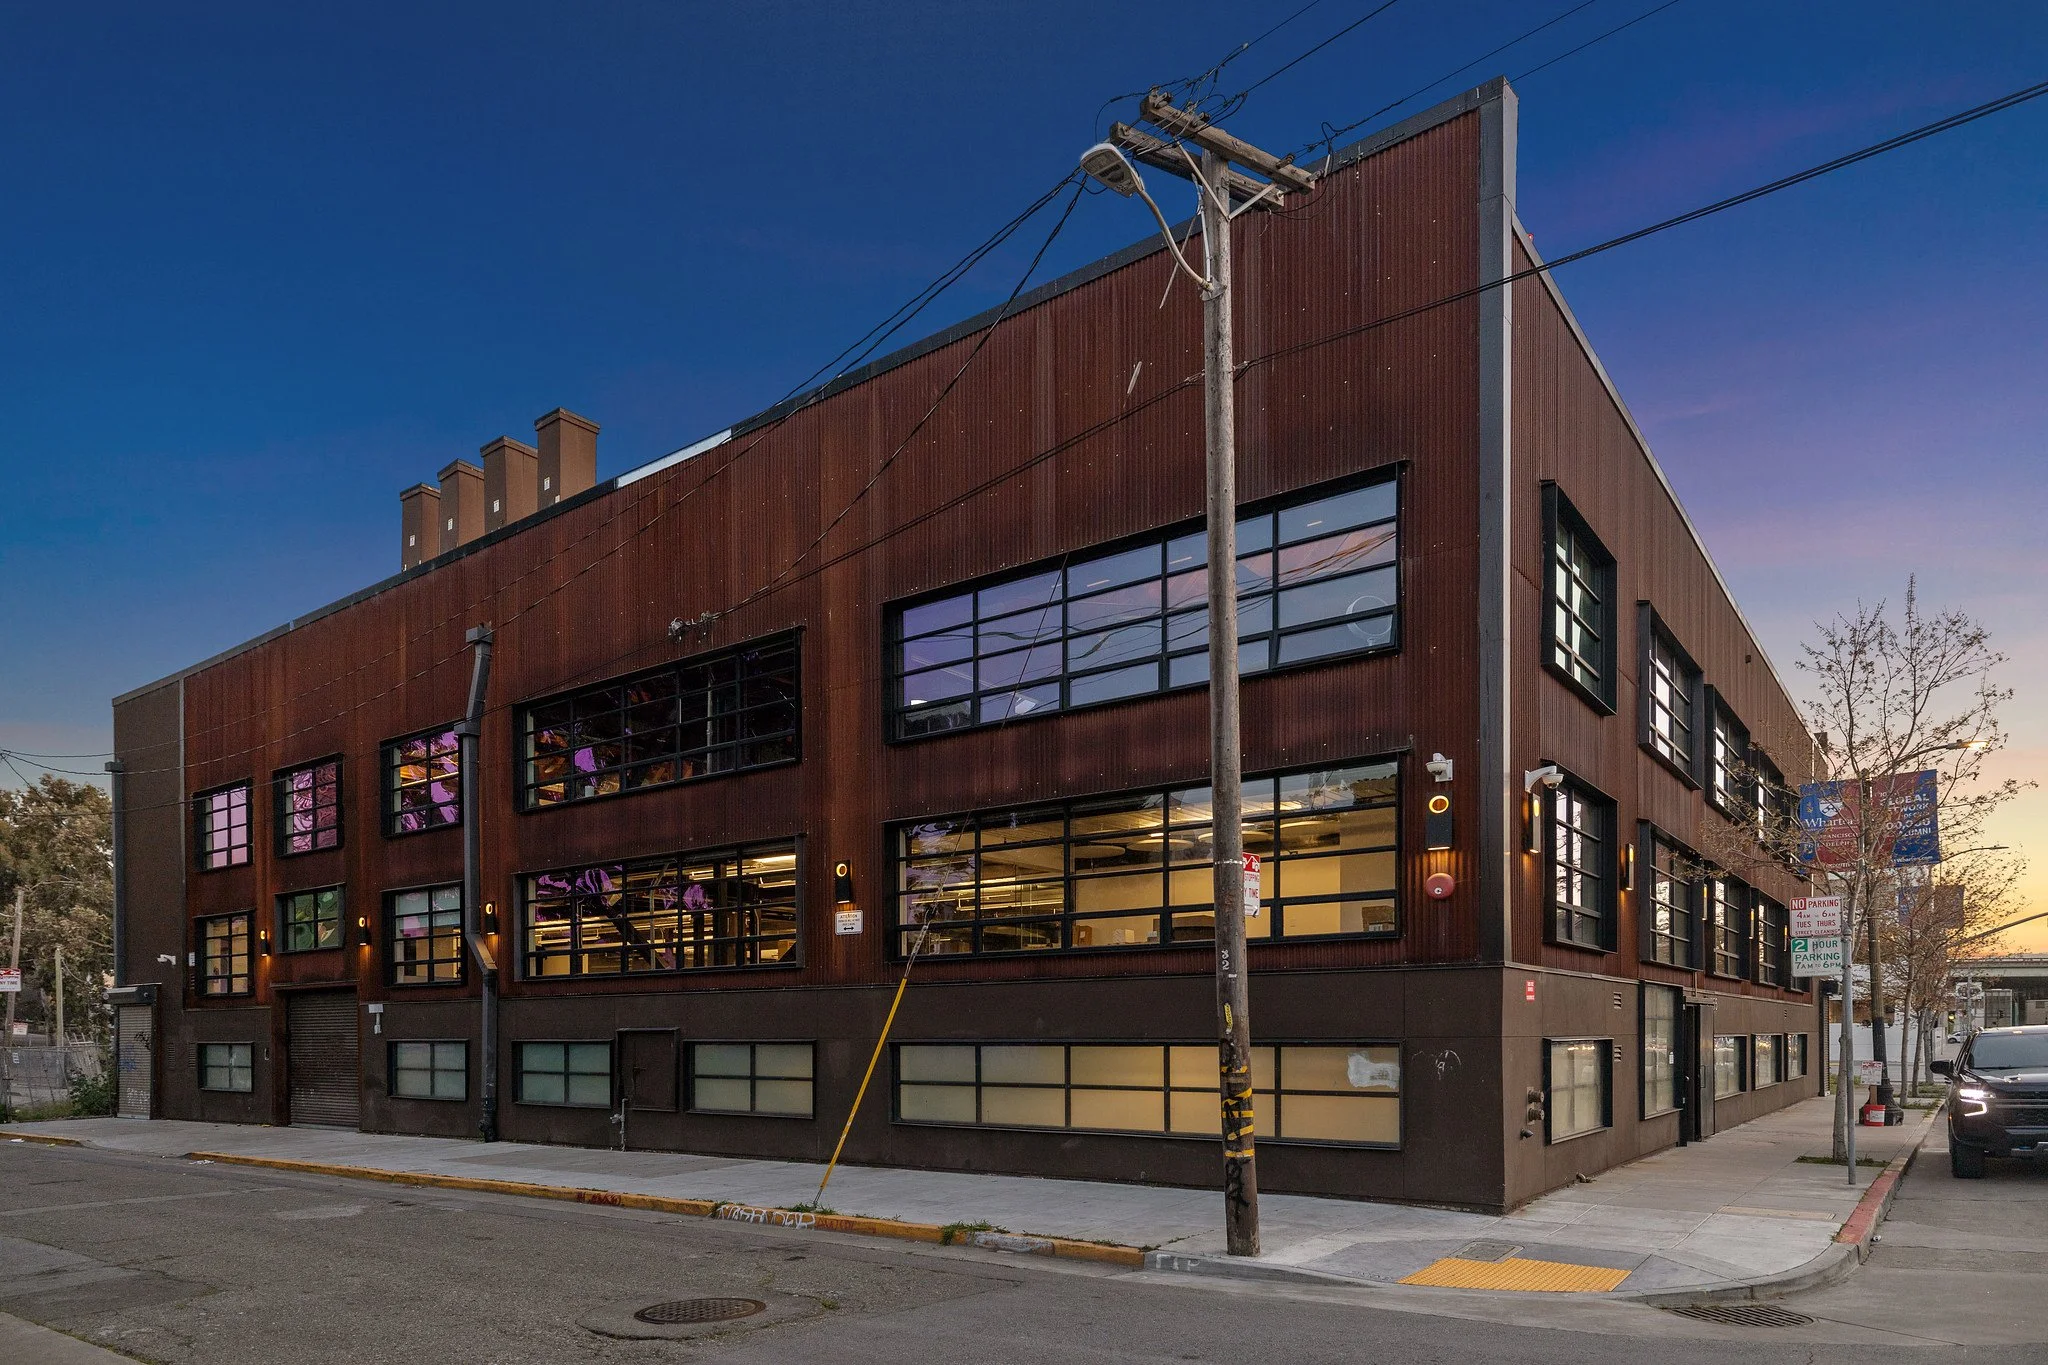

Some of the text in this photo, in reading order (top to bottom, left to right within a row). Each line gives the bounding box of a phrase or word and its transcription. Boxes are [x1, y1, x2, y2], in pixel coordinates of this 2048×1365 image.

[1886, 818, 1931, 830] 00,000
[1792, 899, 1839, 910] NO PARKING
[1796, 911, 1811, 919] 4AM
[1821, 910, 1836, 918] 6AM
[1796, 919, 1837, 929] TUES THURS
[1794, 939, 1838, 952] 2 HOUR
[1795, 952, 1840, 962] PARKING
[1794, 961, 1814, 970] 7AM
[1822, 960, 1842, 969] 6PM
